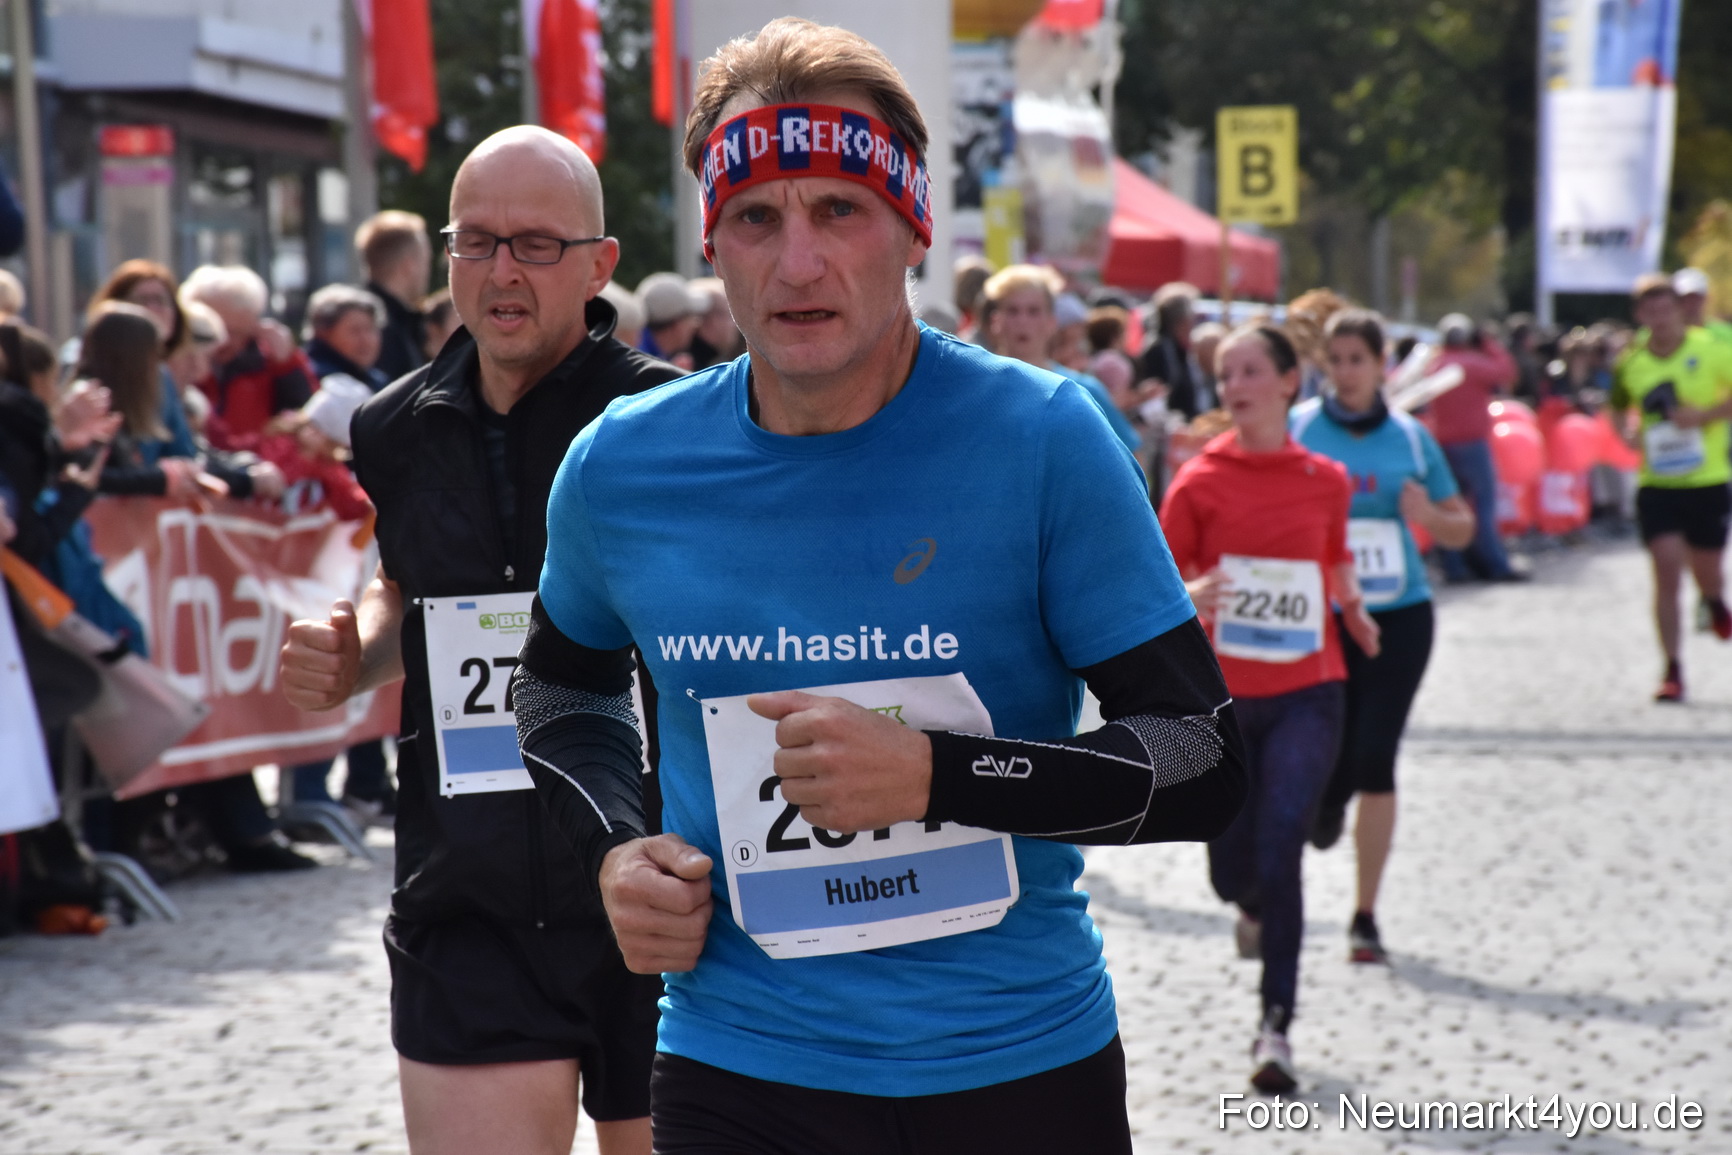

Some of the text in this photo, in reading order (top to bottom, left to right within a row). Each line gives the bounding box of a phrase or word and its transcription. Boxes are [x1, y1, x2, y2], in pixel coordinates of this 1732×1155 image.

[1240, 144, 1275, 197] B
[498, 611, 531, 629] BO
[1235, 590, 1309, 622] 2240
[657, 624, 959, 661] www.hasit.de
[740, 847, 750, 861] D
[824, 869, 920, 905] Hubert
